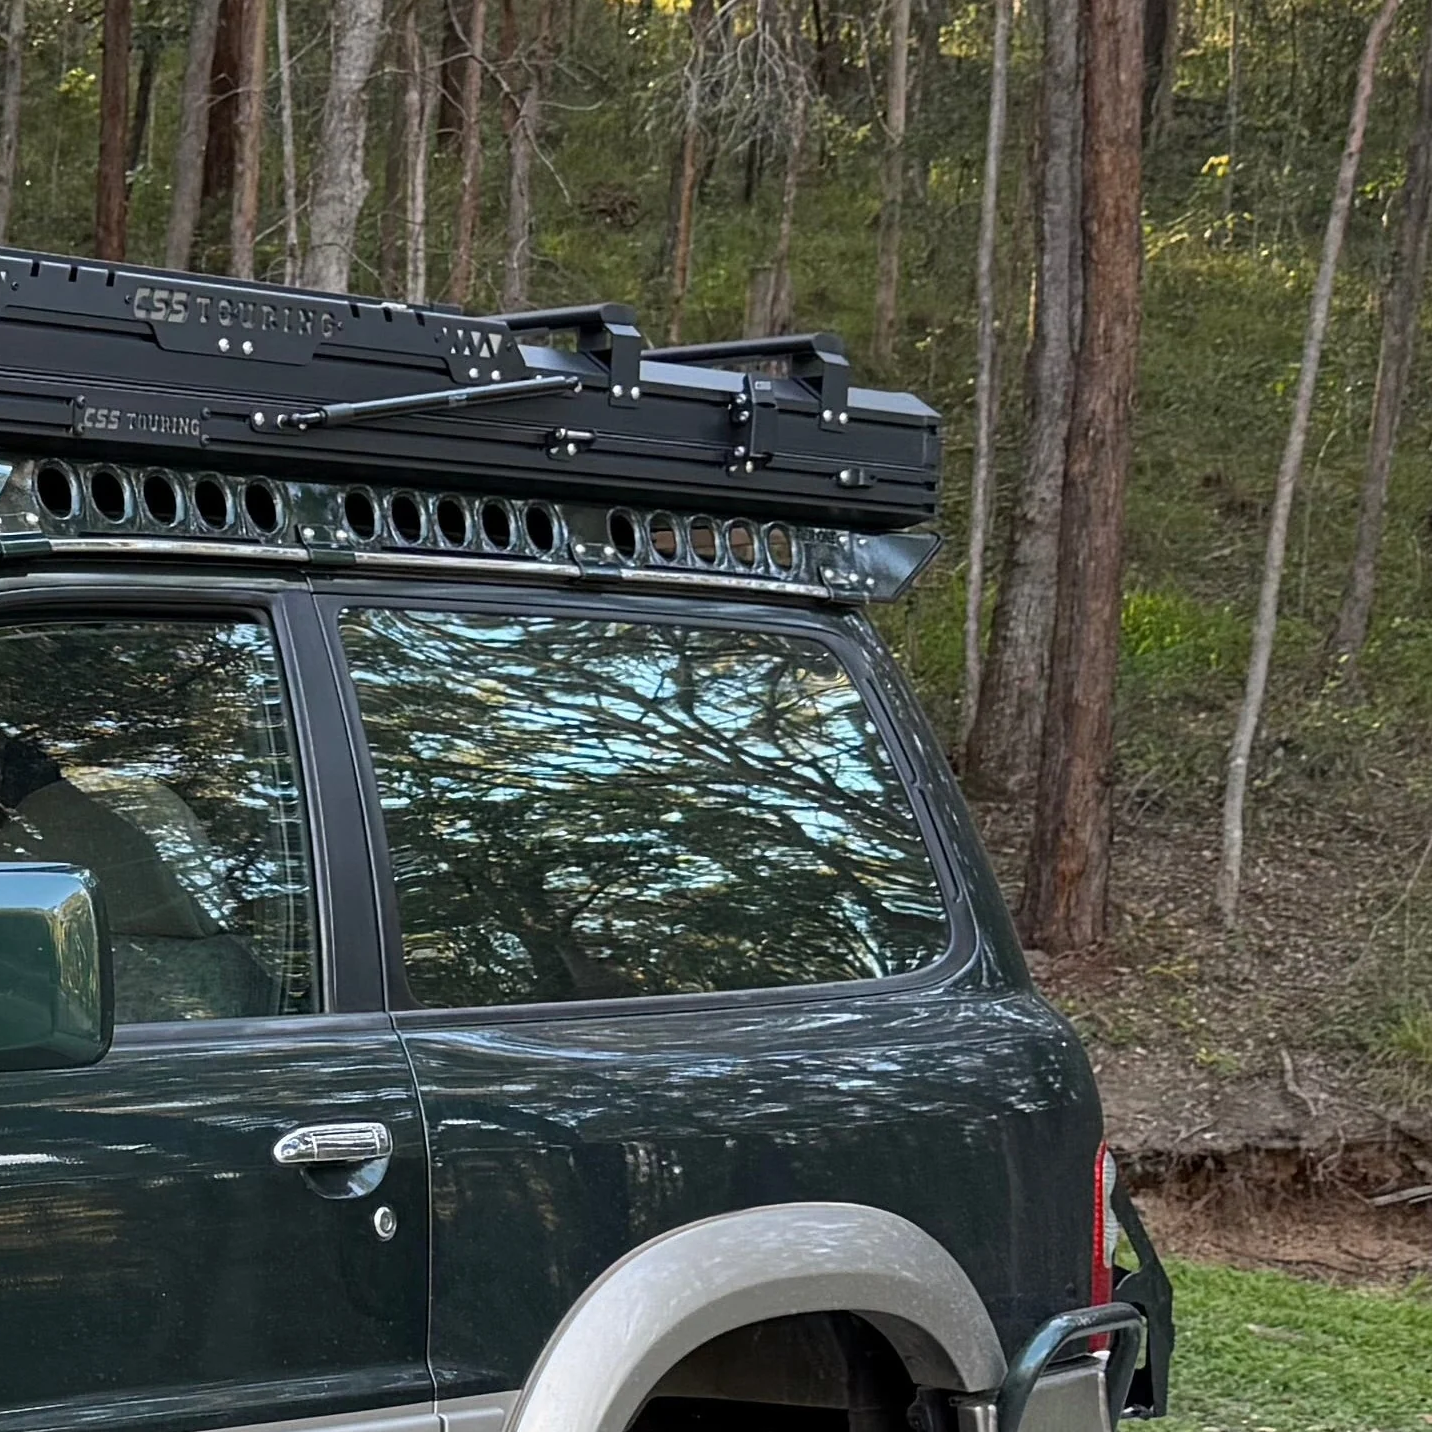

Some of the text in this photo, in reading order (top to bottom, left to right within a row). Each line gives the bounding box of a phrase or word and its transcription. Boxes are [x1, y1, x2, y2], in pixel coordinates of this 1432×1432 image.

[133, 286, 336, 338] CSS TOURING
[84, 407, 200, 436] CSS TOURING
